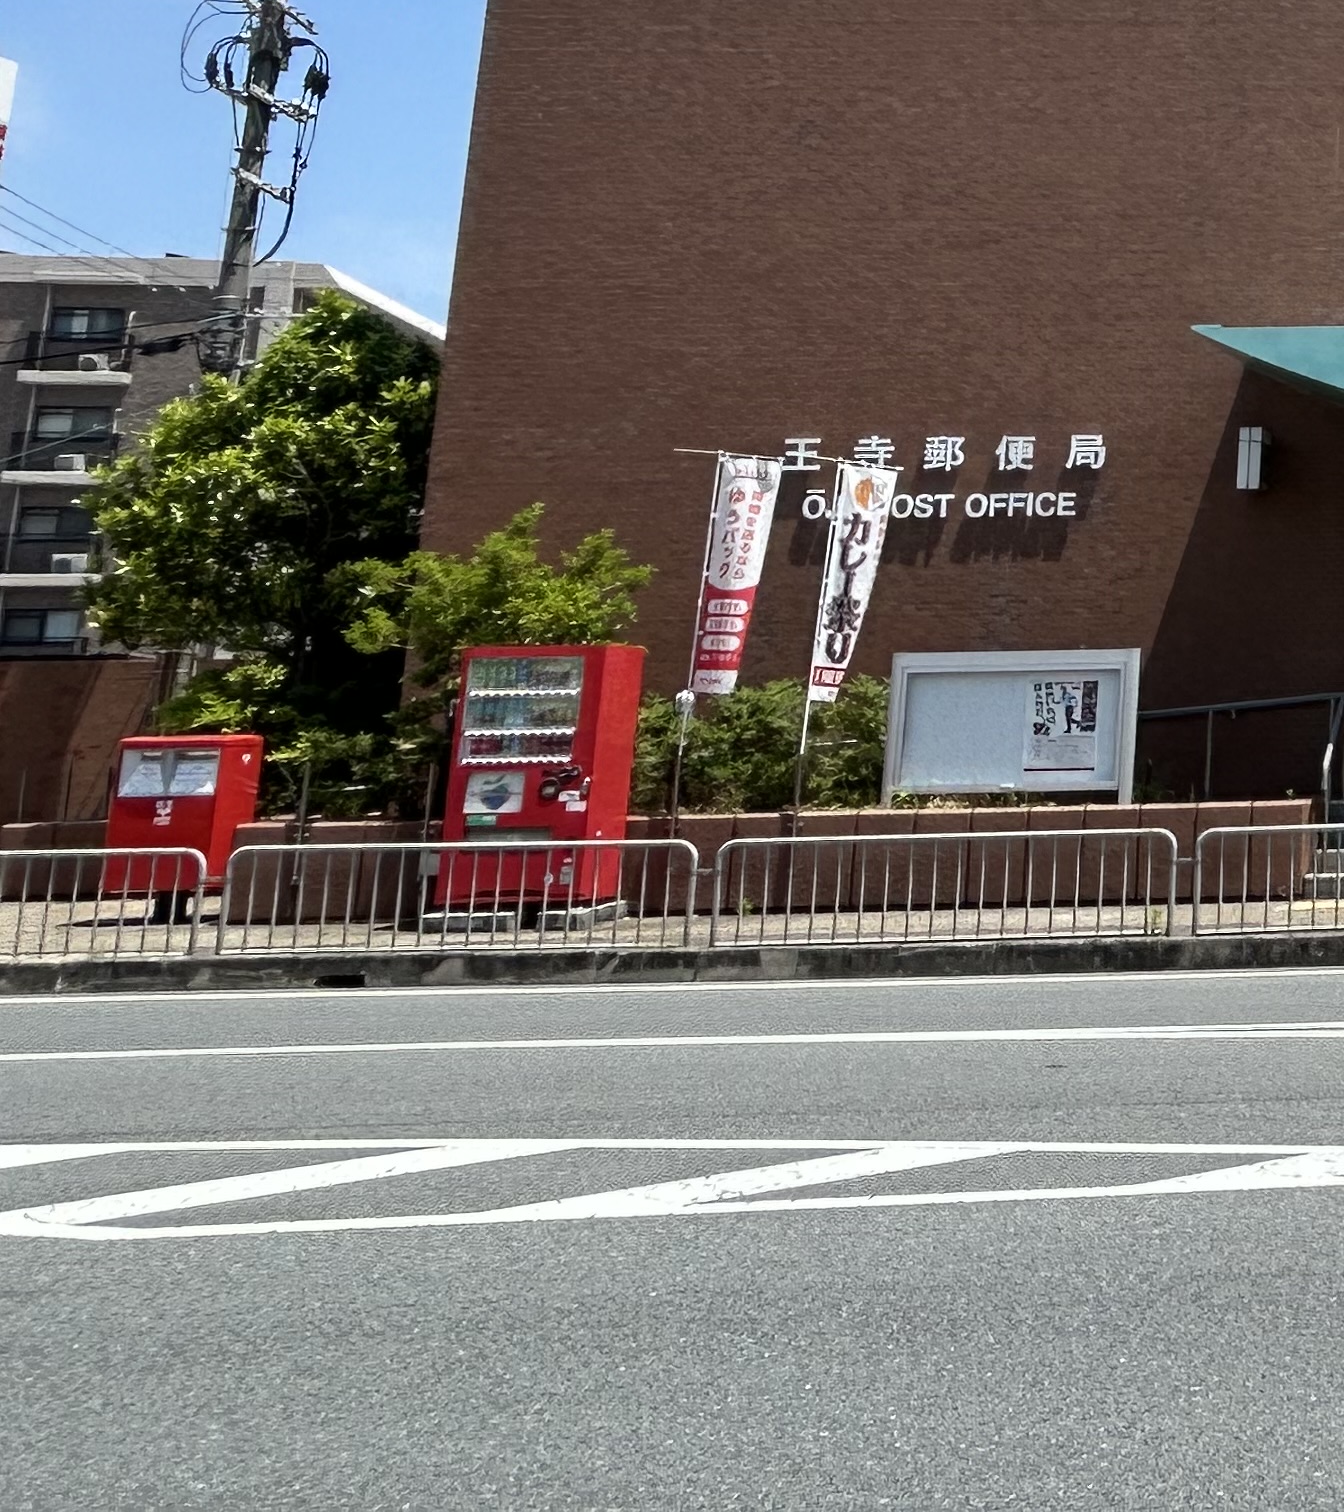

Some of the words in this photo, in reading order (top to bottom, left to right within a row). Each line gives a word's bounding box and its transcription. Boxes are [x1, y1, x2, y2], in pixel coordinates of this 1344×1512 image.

[782, 434, 1106, 472] 王寺郵便局
[892, 492, 955, 519] OST
[964, 491, 1077, 518] OFFICE
[822, 512, 871, 664] カレー祭り
